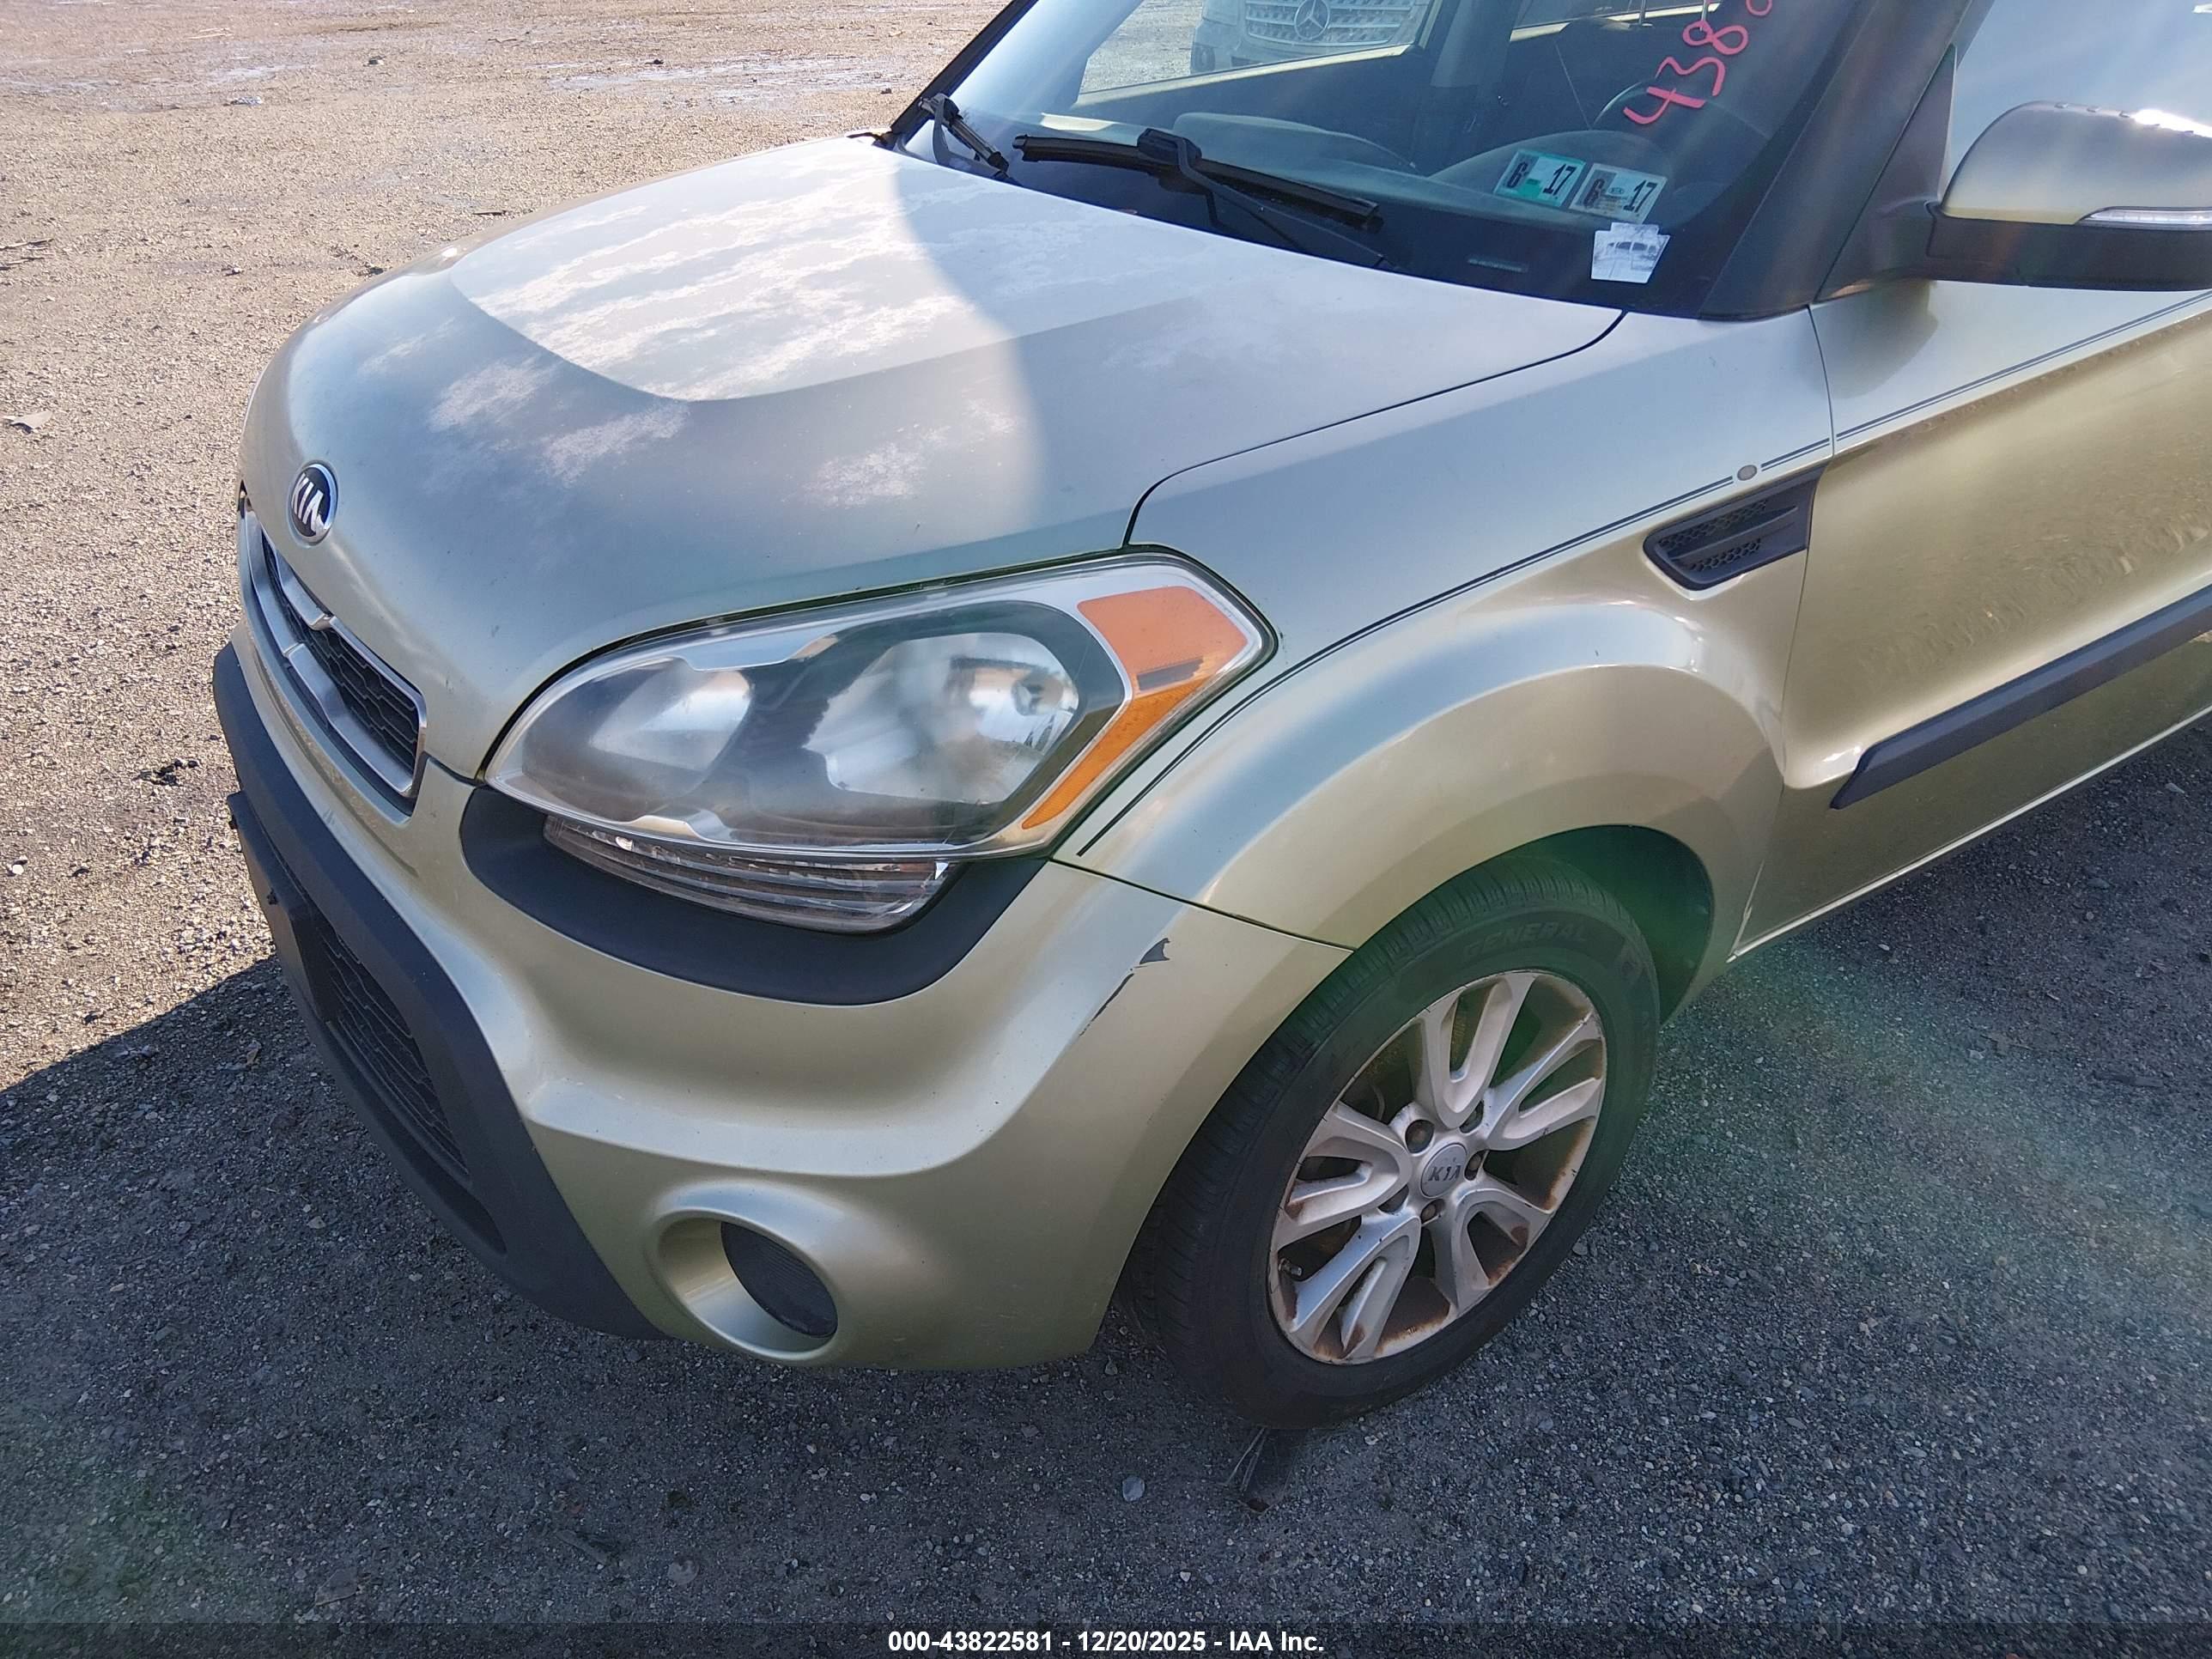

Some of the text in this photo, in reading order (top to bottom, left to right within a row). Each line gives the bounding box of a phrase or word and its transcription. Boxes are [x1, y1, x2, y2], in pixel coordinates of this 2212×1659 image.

[1542, 163, 1577, 197] 17
[1623, 179, 1658, 213] 17
[291, 471, 324, 532] KIA
[1463, 921, 1587, 960] GENERAL
[1427, 1164, 1462, 1182] KIA
